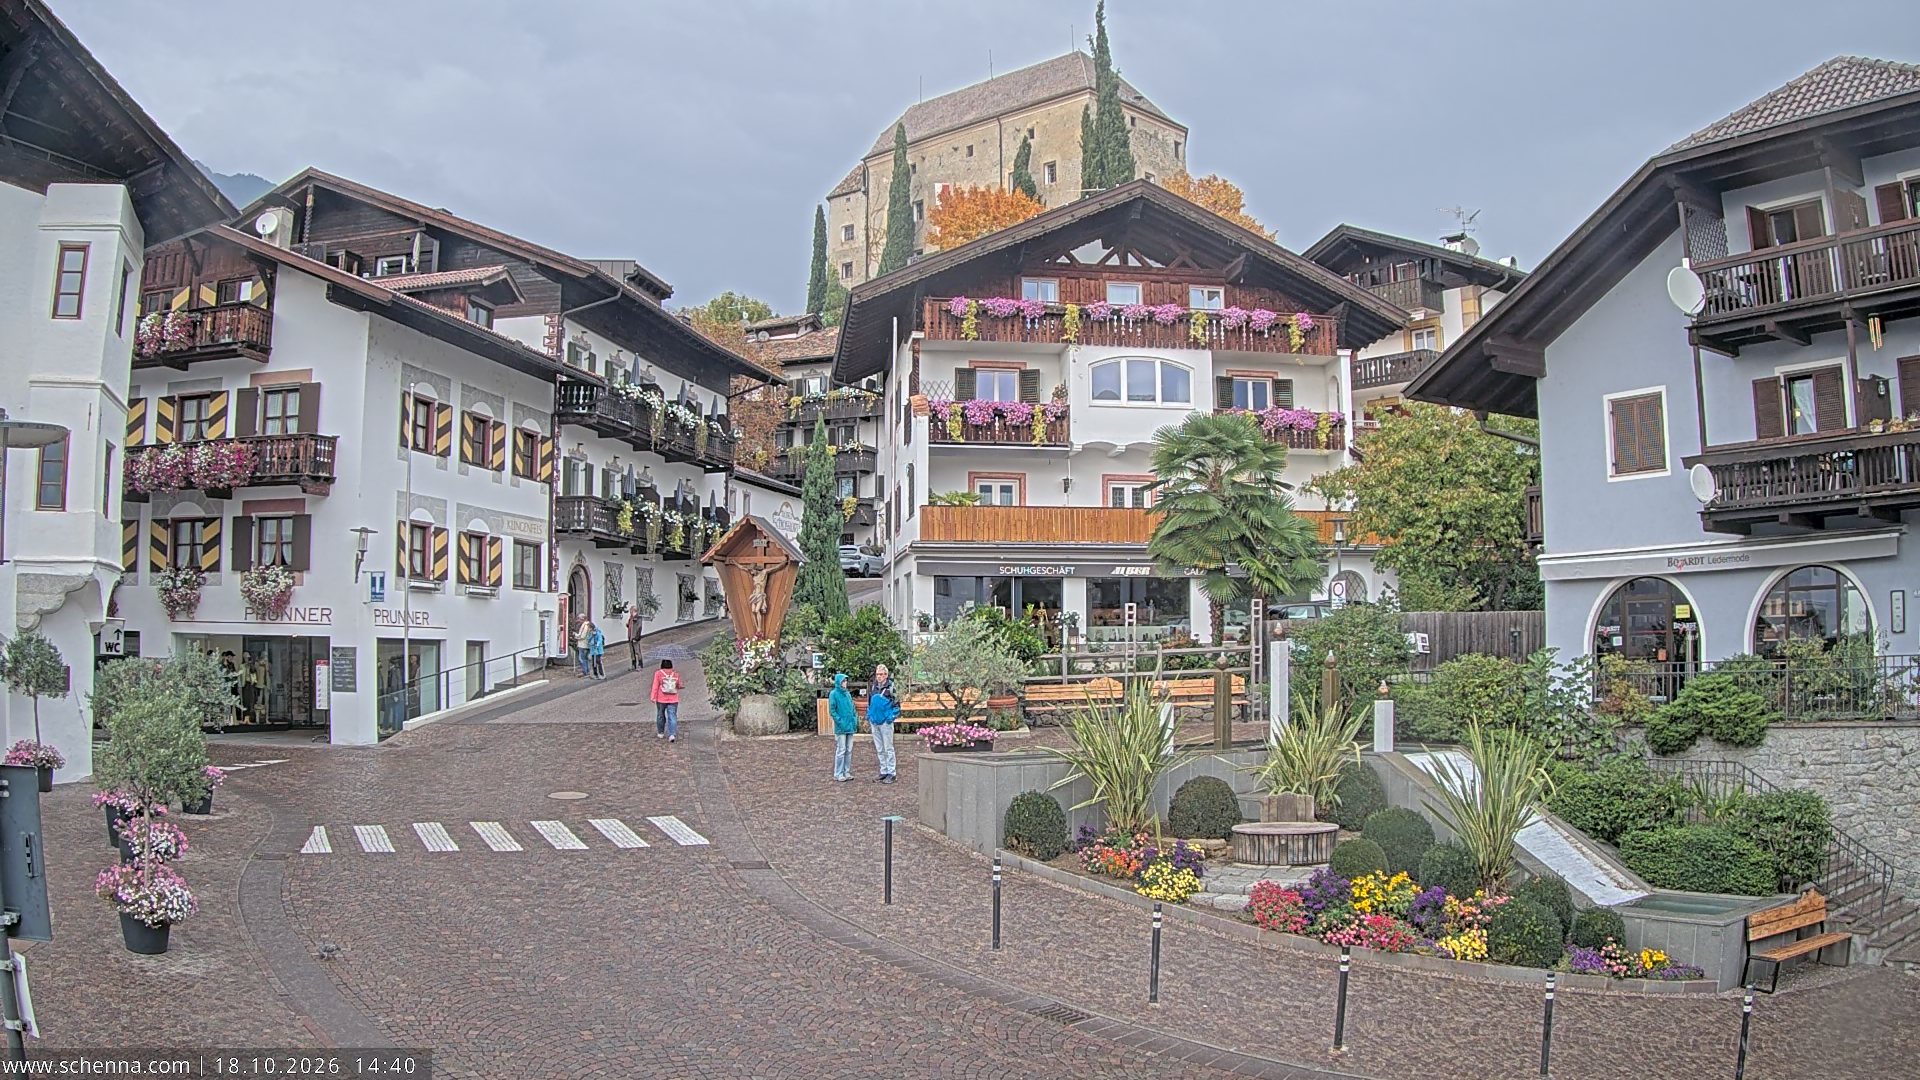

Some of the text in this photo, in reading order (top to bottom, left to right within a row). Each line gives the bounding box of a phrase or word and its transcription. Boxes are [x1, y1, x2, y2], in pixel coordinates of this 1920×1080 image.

[1707, 553, 1750, 564] Ledermode
[999, 565, 1076, 575] SCHUHGESCHÄFT
[374, 609, 430, 625] PRUNNER
[105, 642, 121, 653] WC
